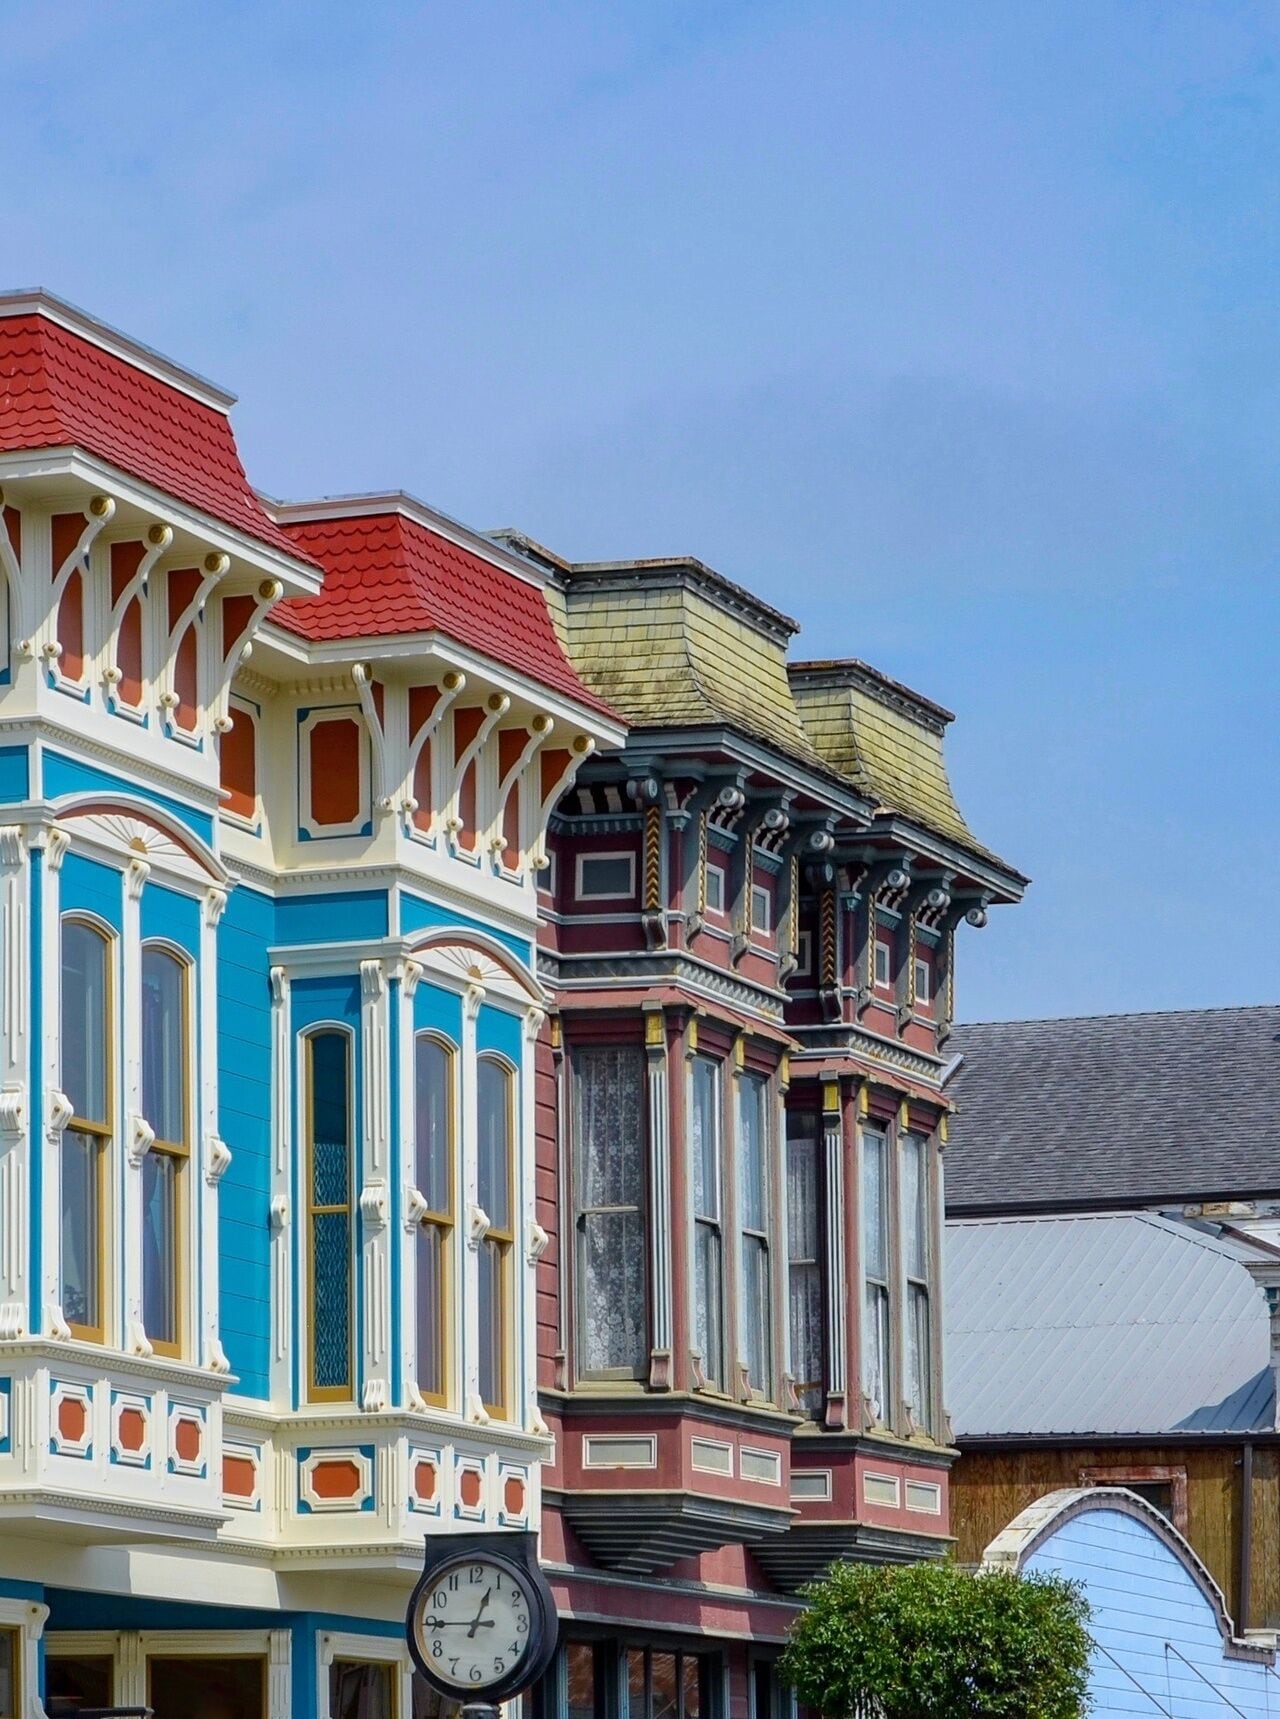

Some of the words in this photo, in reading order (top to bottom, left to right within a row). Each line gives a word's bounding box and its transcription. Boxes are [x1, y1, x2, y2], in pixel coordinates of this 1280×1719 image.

[448, 1574, 460, 1591] 11
[469, 1566, 484, 1584] 12
[496, 1572, 501, 1590] 1
[432, 1591, 448, 1609] 10
[511, 1590, 521, 1608] 2
[425, 1615, 438, 1634] 9
[516, 1614, 528, 1633] 3
[432, 1640, 443, 1658] 8
[507, 1640, 521, 1657] 4
[448, 1657, 461, 1676] 7
[469, 1664, 482, 1682] 6
[493, 1657, 505, 1674] 5
